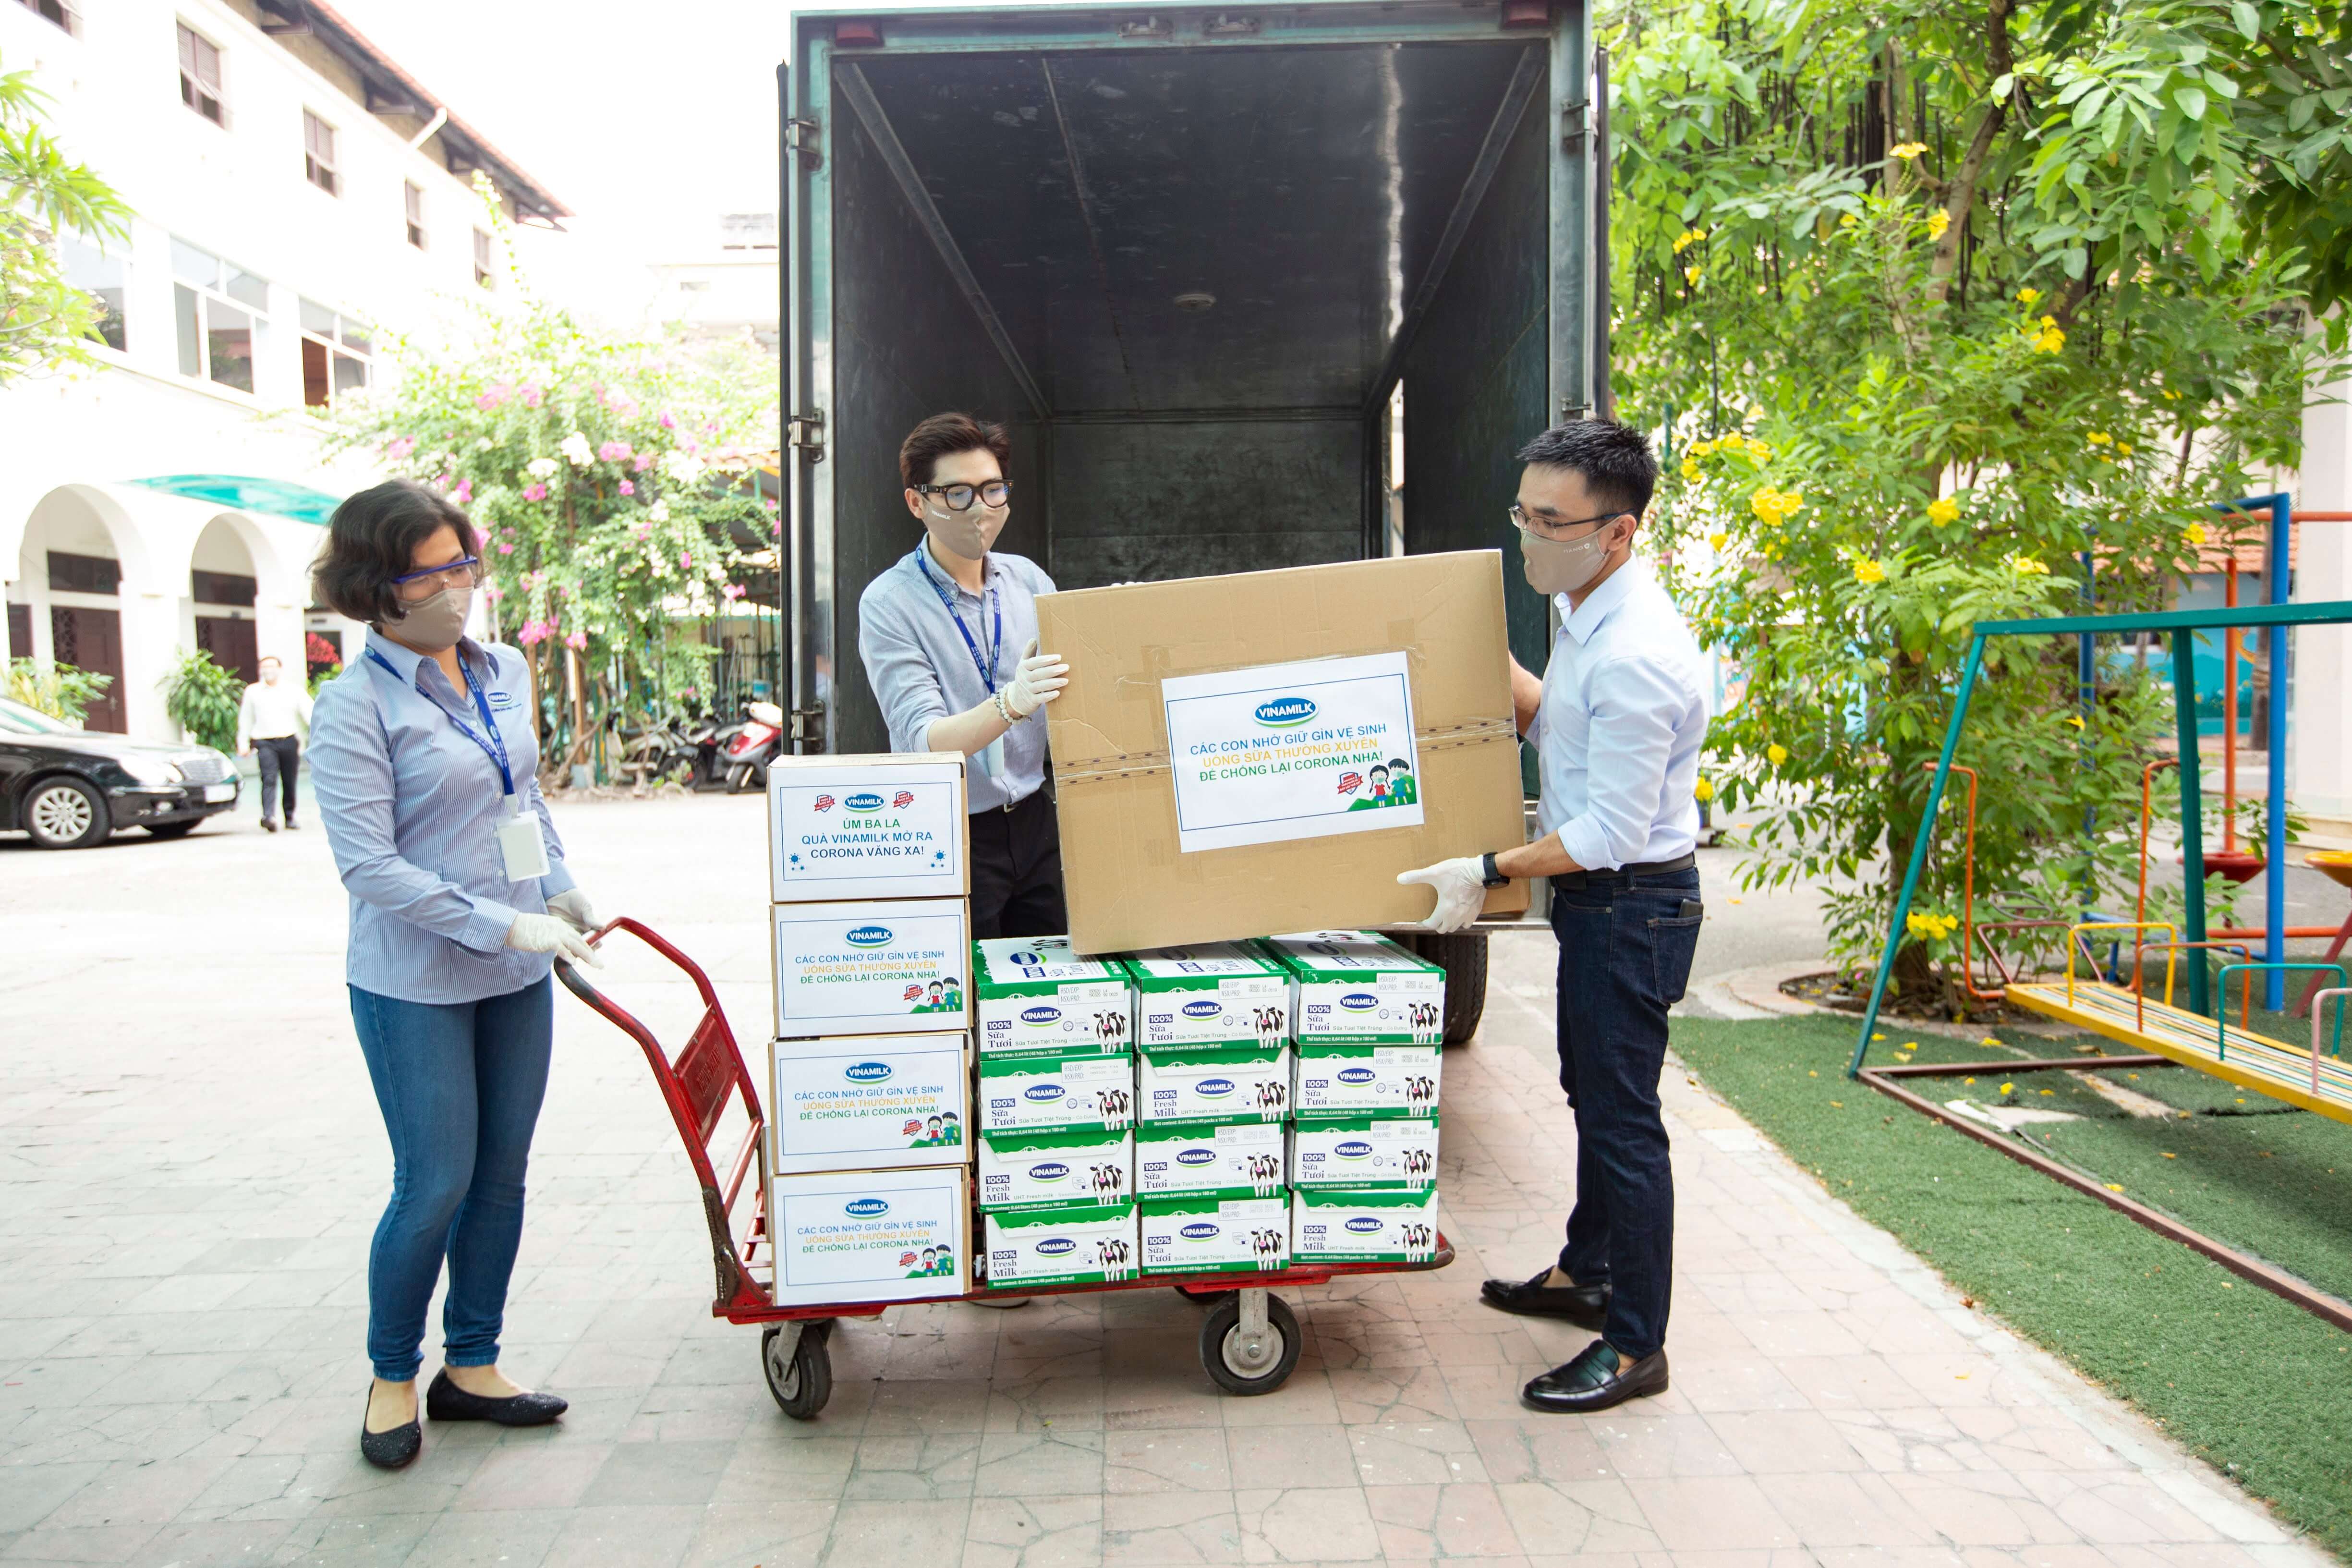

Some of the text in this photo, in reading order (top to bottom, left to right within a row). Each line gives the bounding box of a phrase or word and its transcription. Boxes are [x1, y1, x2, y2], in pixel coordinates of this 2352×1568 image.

[1259, 703, 1313, 718] VINAMILK
[1190, 742, 1216, 755] CÁC
[1221, 740, 1249, 751] CON
[1311, 729, 1334, 741] GÌN
[1357, 723, 1386, 735] SINH
[1335, 737, 1378, 751] XUYÊN
[1271, 762, 1291, 775] LẠI
[1294, 755, 1350, 770] CORONA
[1353, 751, 1383, 764] NHA!
[847, 798, 883, 806] VINAMILK
[843, 818, 900, 829] ÚM BA LA
[801, 830, 933, 845] QUÀ VINAMILK MỞ RA
[810, 845, 923, 858] CORONA VĂNG XA!
[849, 931, 890, 940] VINAMILK
[795, 954, 815, 963] CÁC
[854, 973, 870, 982] LẠI
[873, 972, 914, 980] CORONA
[1184, 1005, 1220, 1013] VINAMILK
[1023, 1011, 1059, 1019] VINAMILK
[1307, 1022, 1330, 1031] Tươi
[1149, 1032, 1172, 1041] Tươi
[988, 1038, 1012, 1048] Tươi
[848, 1067, 890, 1076] VINAMILK
[1197, 1083, 1233, 1091] VINAMILK
[794, 1091, 814, 1100] CÁC
[818, 1091, 839, 1099] CON
[1026, 1088, 1064, 1097] VINAMILK
[1305, 1097, 1327, 1106] Tươi
[853, 1109, 869, 1118] LẠI
[872, 1106, 913, 1116] CORONA
[916, 1106, 939, 1114] NHA!
[992, 1109, 1008, 1117] Sữa
[1154, 1108, 1176, 1117] Milk
[992, 1116, 1016, 1126] Tươi
[1031, 1168, 1068, 1176] VINAMILK
[1302, 1170, 1324, 1179] Tươi
[1144, 1179, 1167, 1188] Tươi
[986, 1193, 1010, 1202] Milk
[848, 1203, 886, 1212] VINAMILK
[870, 1240, 909, 1249] CORONA
[1038, 1242, 1074, 1251] VINAMILK
[1303, 1242, 1325, 1251] Milk
[1148, 1253, 1171, 1263] Tươi
[993, 1260, 1017, 1268] Fresh
[994, 1268, 1017, 1277] Milk
